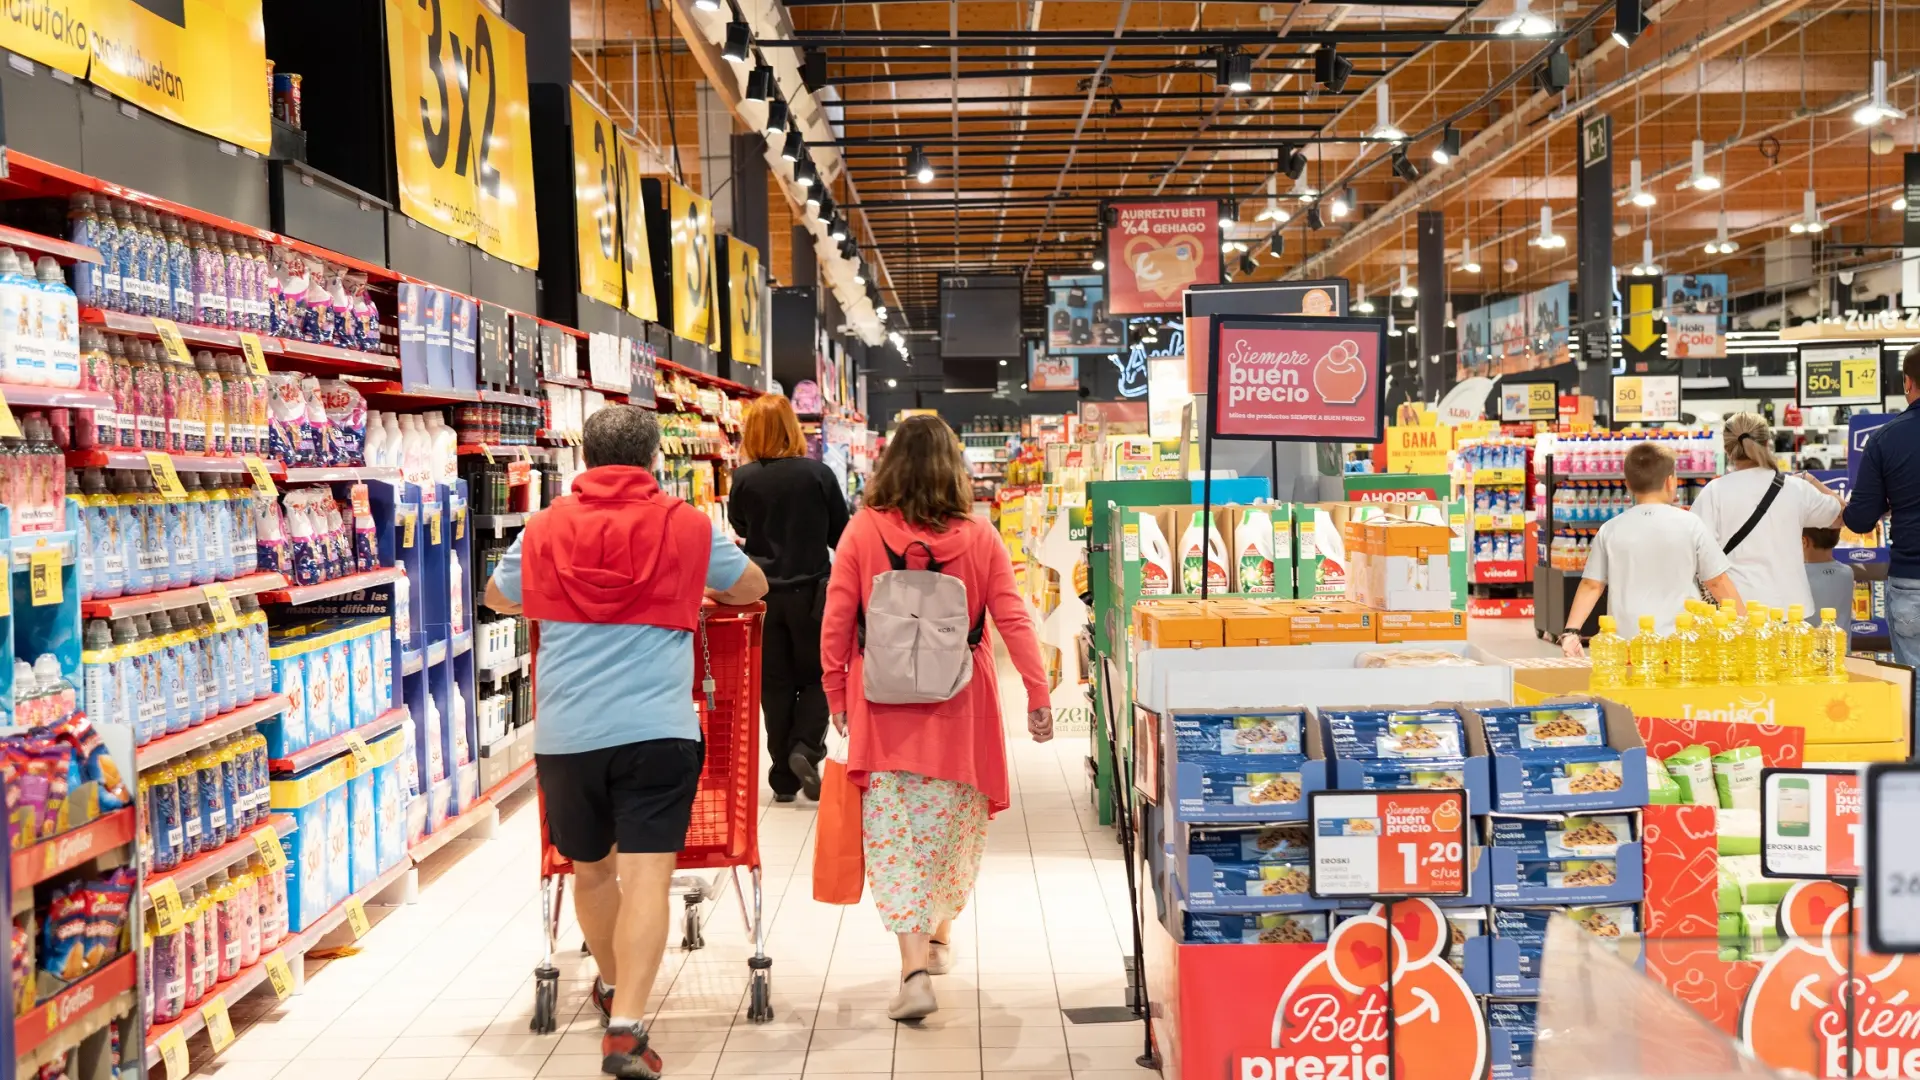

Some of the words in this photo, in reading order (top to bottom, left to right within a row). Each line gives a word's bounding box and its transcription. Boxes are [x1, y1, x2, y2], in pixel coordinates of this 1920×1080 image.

[1121, 208, 1179, 220] AURREZTU
[1181, 207, 1205, 218] BETI
[1121, 219, 1149, 234] %4
[1152, 223, 1205, 234] GEHIAGO
[1844, 308, 1900, 331] Zure
[1680, 324, 1705, 332] Hola
[1679, 333, 1714, 345] Cole
[1227, 339, 1310, 369] Siempre
[1230, 364, 1299, 386] buen
[1808, 374, 1840, 391] 50%
[1229, 386, 1309, 407] precio
[1247, 412, 1256, 420] de
[1256, 412, 1290, 421] productos
[1402, 431, 1437, 449] GANA
[1070, 526, 1087, 540] gul
[1484, 568, 1518, 577] vileda
[371, 592, 388, 600] las
[286, 606, 338, 614] manchas
[340, 604, 387, 613] difíciles
[1471, 607, 1502, 616] ileda
[1520, 605, 1535, 615] vil
[1384, 801, 1432, 816] Siempre
[1835, 804, 1863, 816] pre
[1386, 814, 1425, 825] buen
[1386, 824, 1432, 836] precio
[1289, 993, 1389, 1045] Beti
